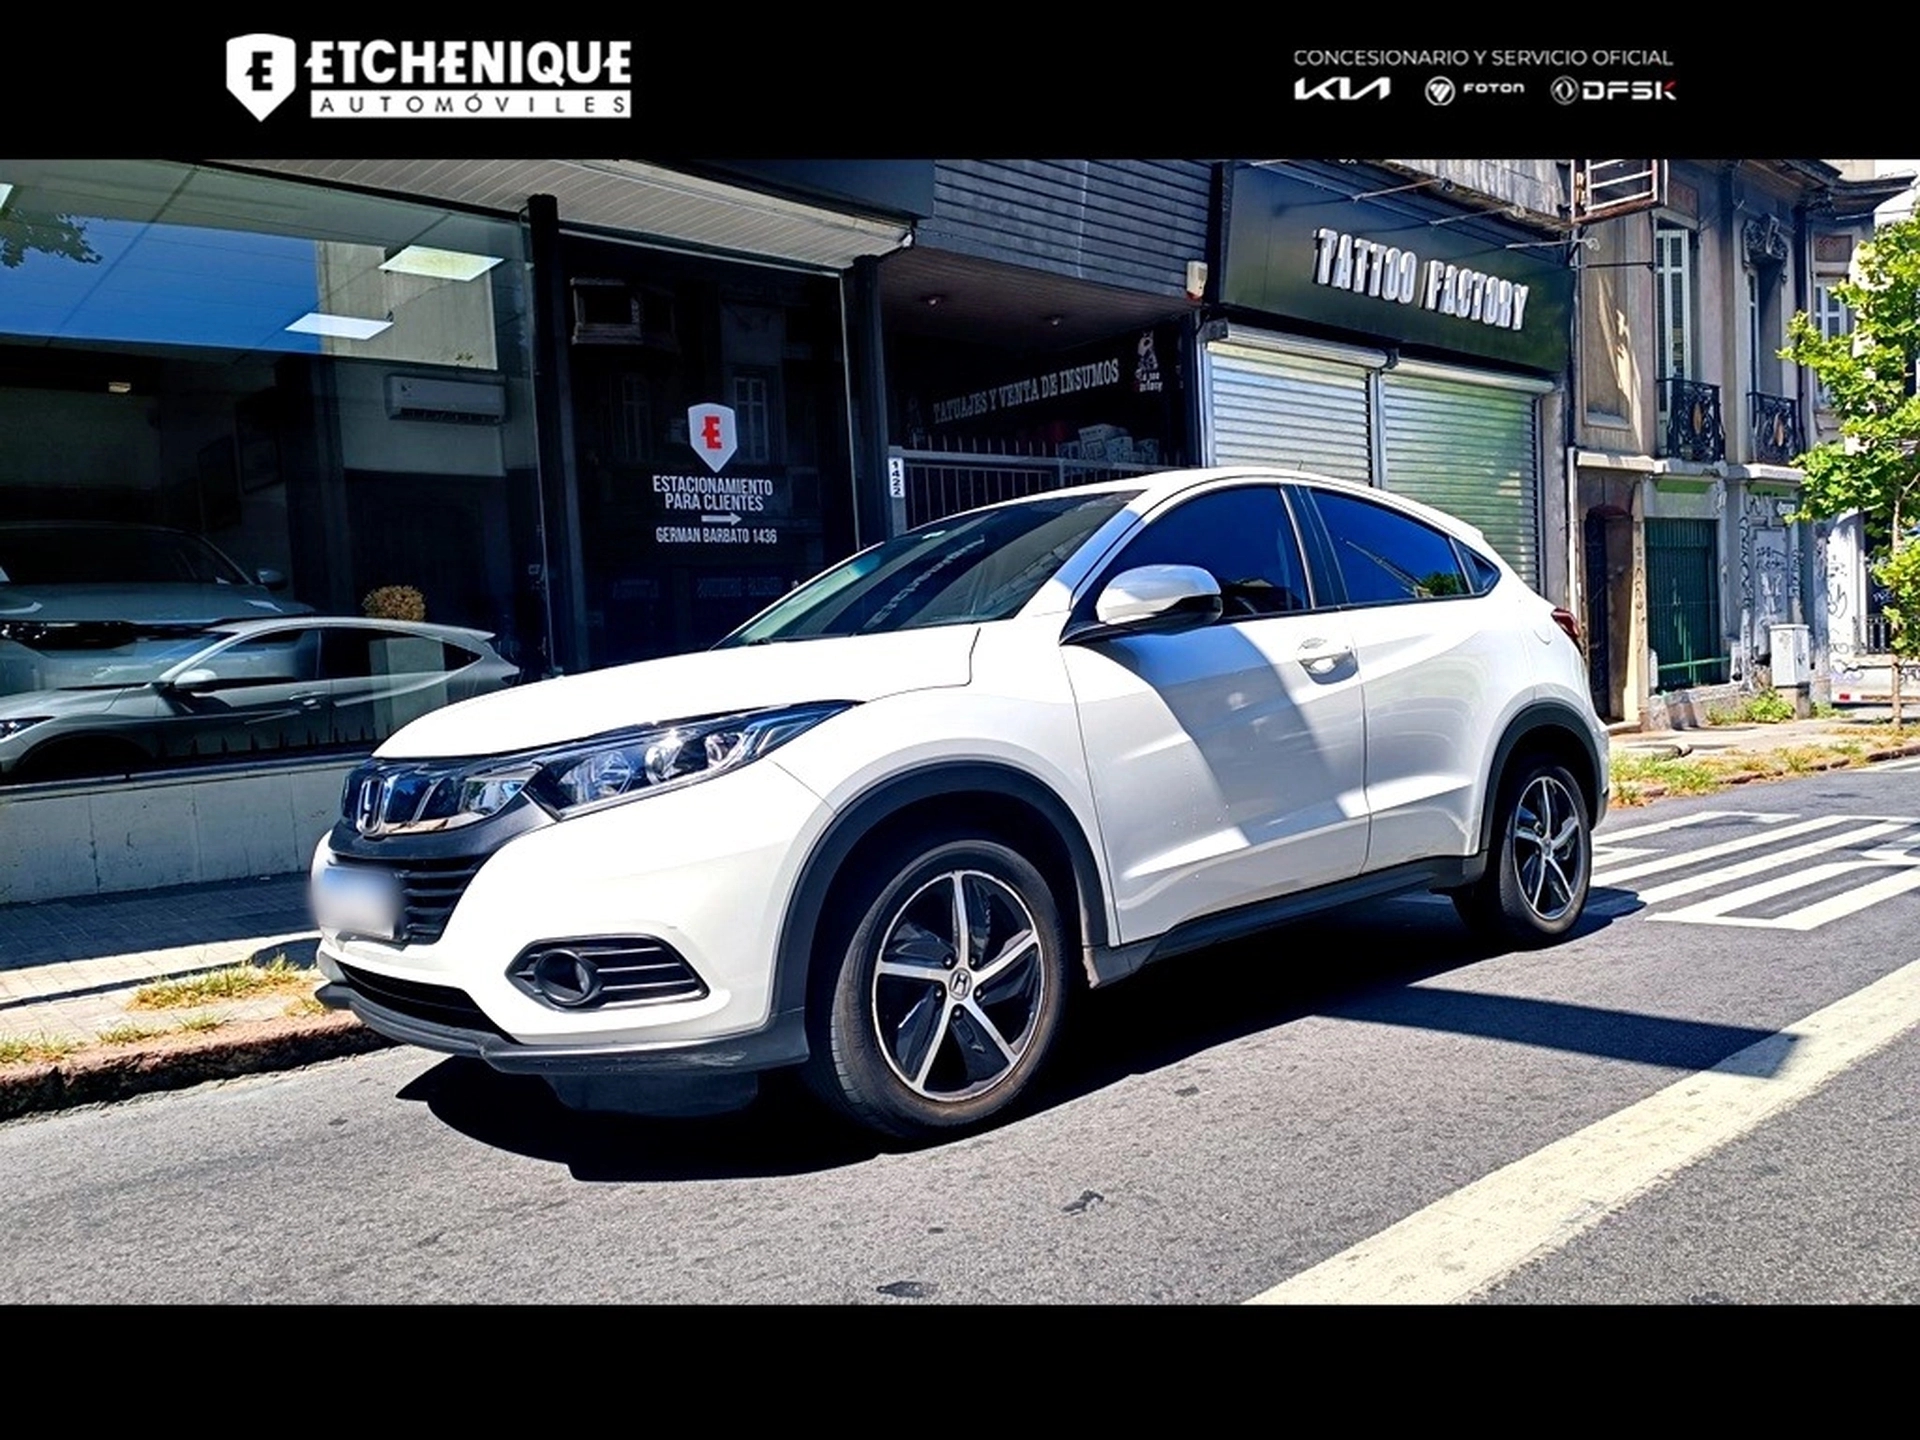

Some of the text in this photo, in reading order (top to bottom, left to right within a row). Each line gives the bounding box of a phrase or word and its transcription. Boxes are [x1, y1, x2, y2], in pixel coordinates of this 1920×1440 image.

[1313, 228, 1529, 330] TATTOO FACTORY
[933, 391, 988, 424] TATUAJES
[989, 388, 997, 411] Y
[1000, 378, 1039, 408] VENTA
[1041, 373, 1057, 398] DE
[1059, 358, 1120, 394] INSUMOS
[652, 475, 773, 496] ESTACIONAMIENTO
[665, 493, 763, 511] PARA CLIENTES
[656, 527, 777, 544] GERMAN BARBATO 1436
